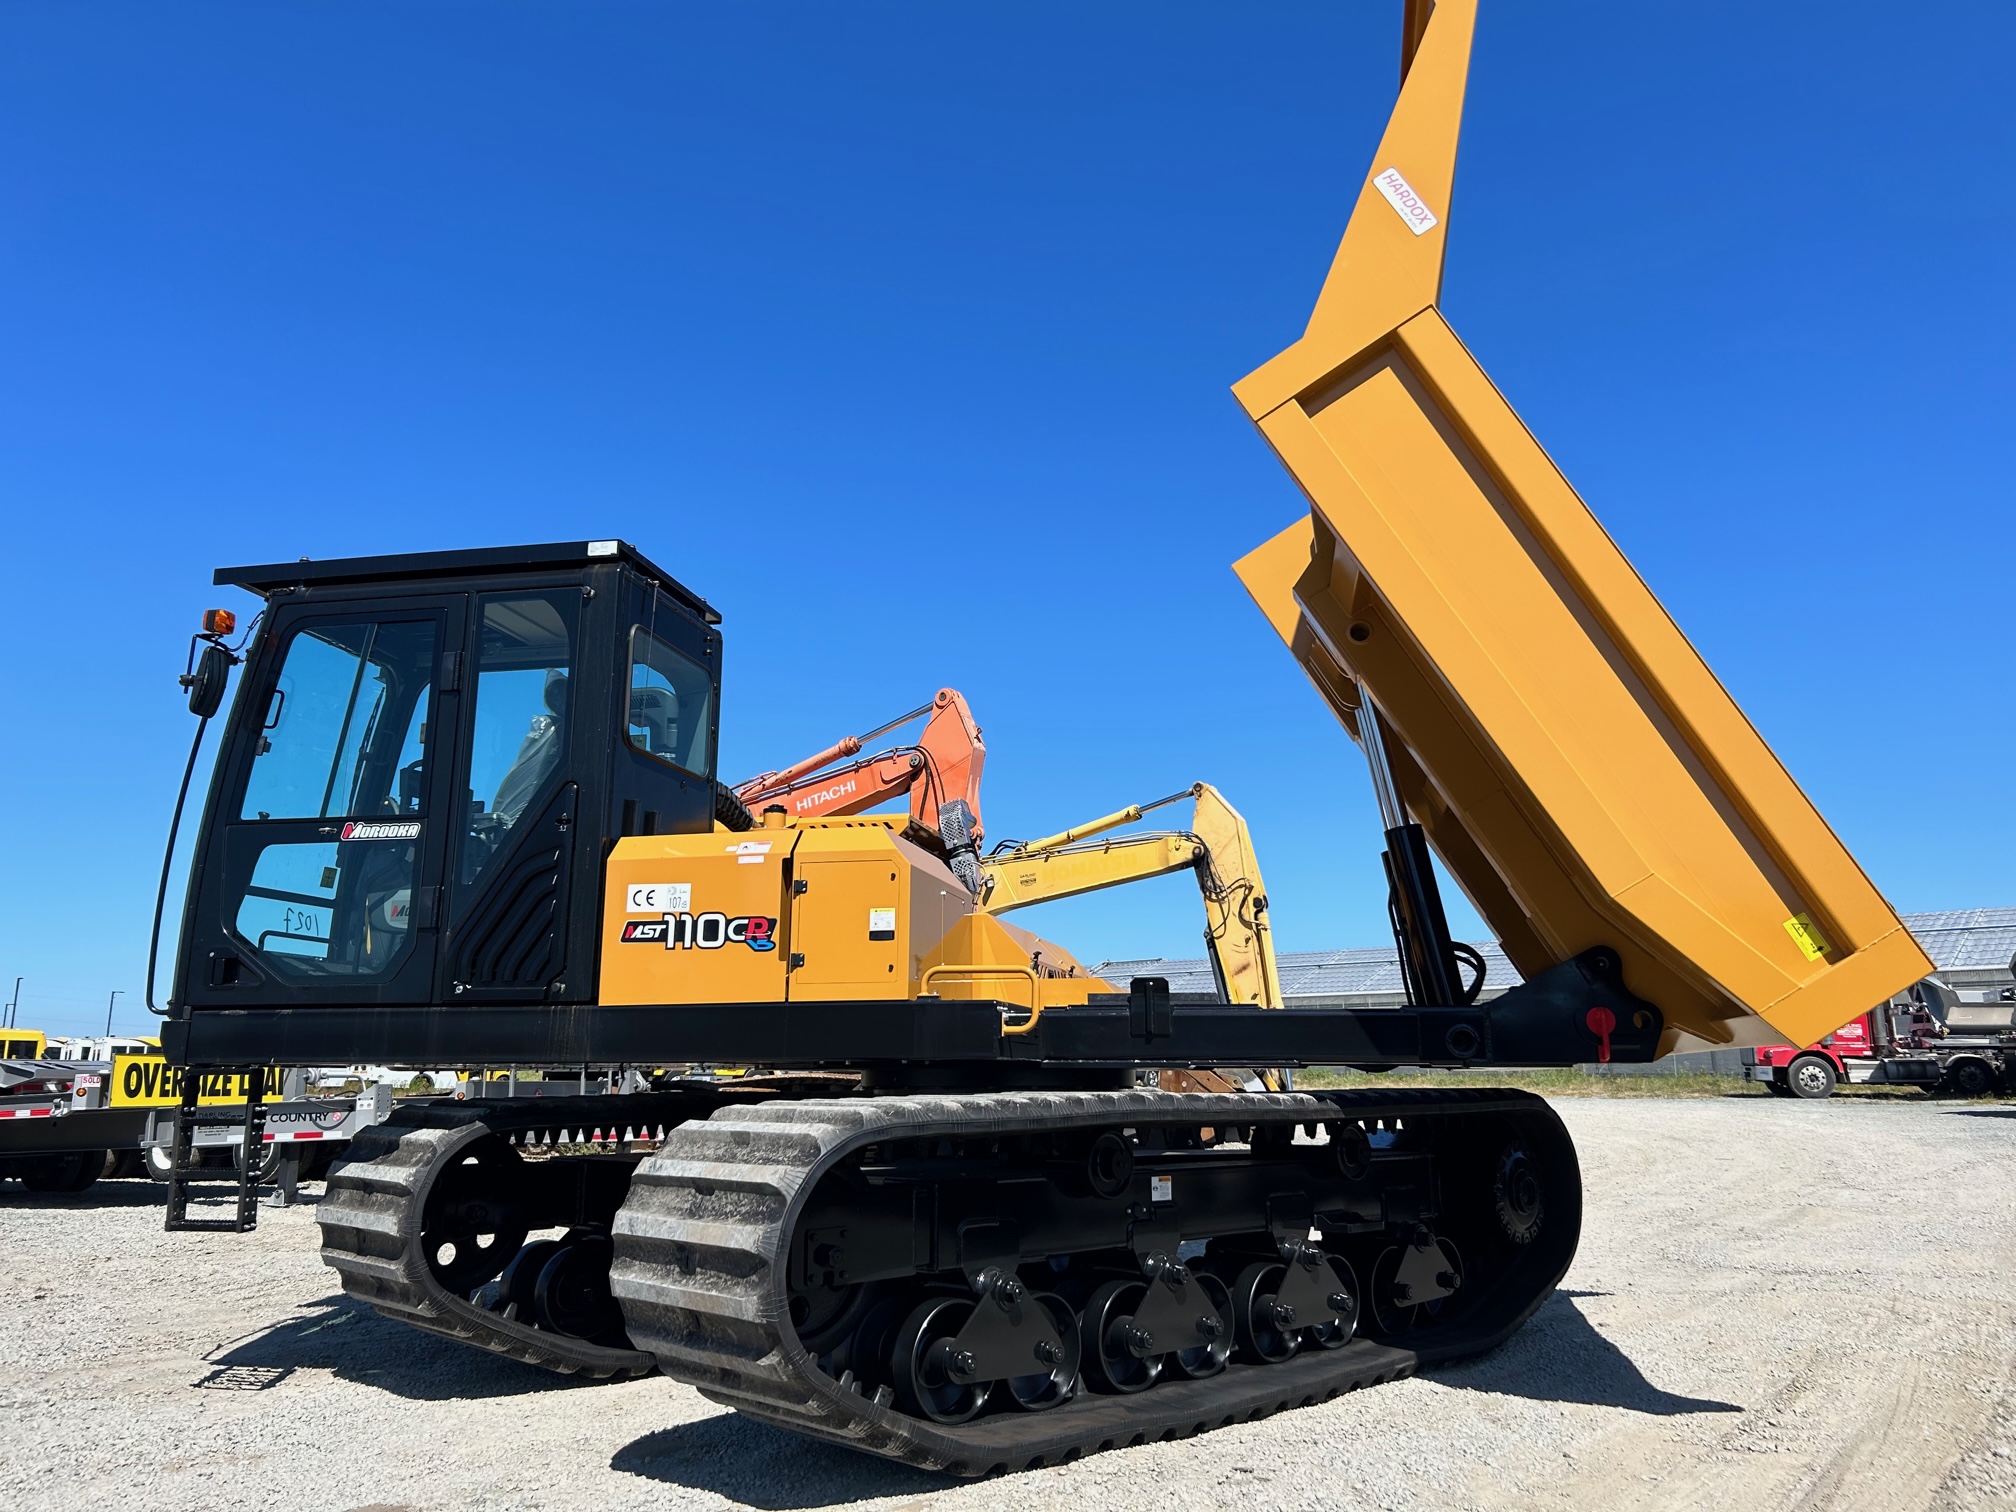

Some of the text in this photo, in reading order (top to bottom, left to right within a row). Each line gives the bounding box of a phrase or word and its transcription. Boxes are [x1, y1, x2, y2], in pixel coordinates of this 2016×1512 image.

[1382, 173, 1432, 225] HARDOX
[796, 780, 856, 812] HITACHI
[342, 823, 418, 840] MOROOKA
[632, 889, 656, 907] CE
[82, 1076, 101, 1085] SOLD
[123, 1062, 232, 1099] OVERIZE
[270, 1112, 330, 1123] COUNTRY
